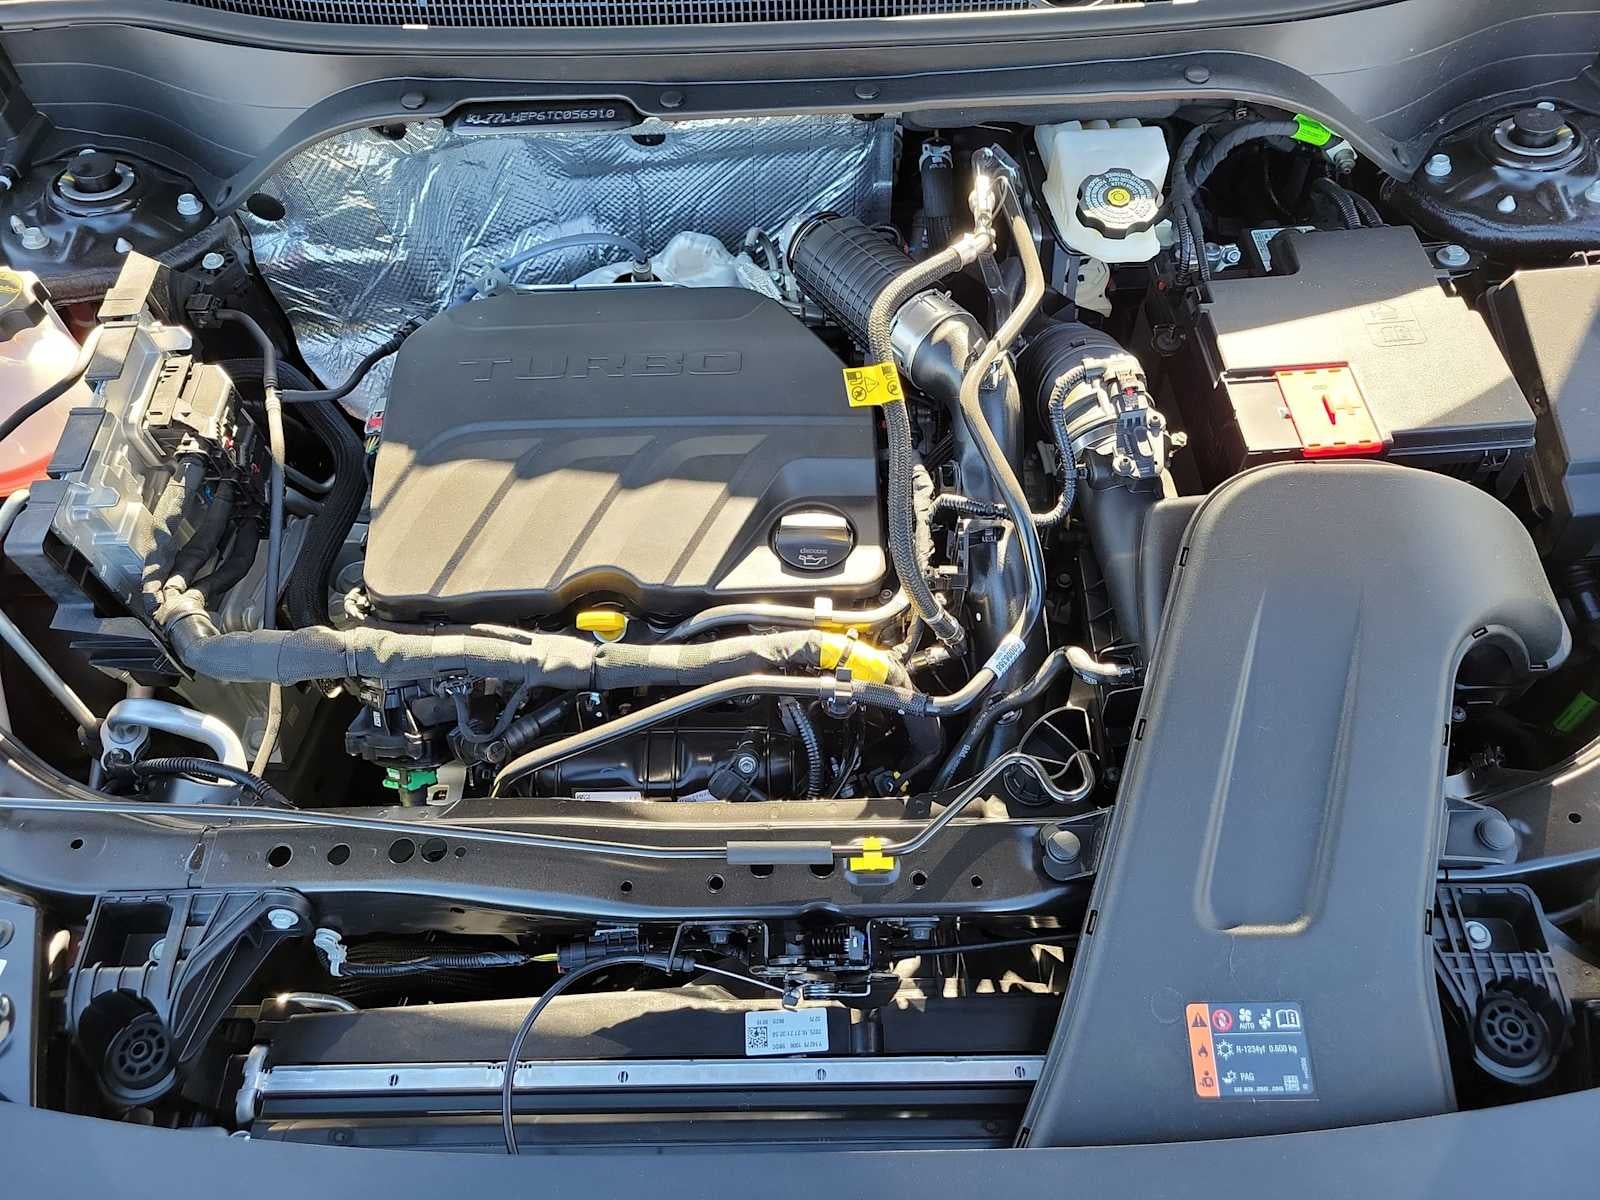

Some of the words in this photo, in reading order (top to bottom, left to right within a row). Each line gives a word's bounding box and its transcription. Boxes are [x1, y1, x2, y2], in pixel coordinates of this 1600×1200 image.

[457, 351, 742, 382] TURBO
[1240, 1022, 1255, 1030] AUTO
[1288, 1044, 1298, 1054] kg
[1240, 1072, 1255, 1081] PAG
